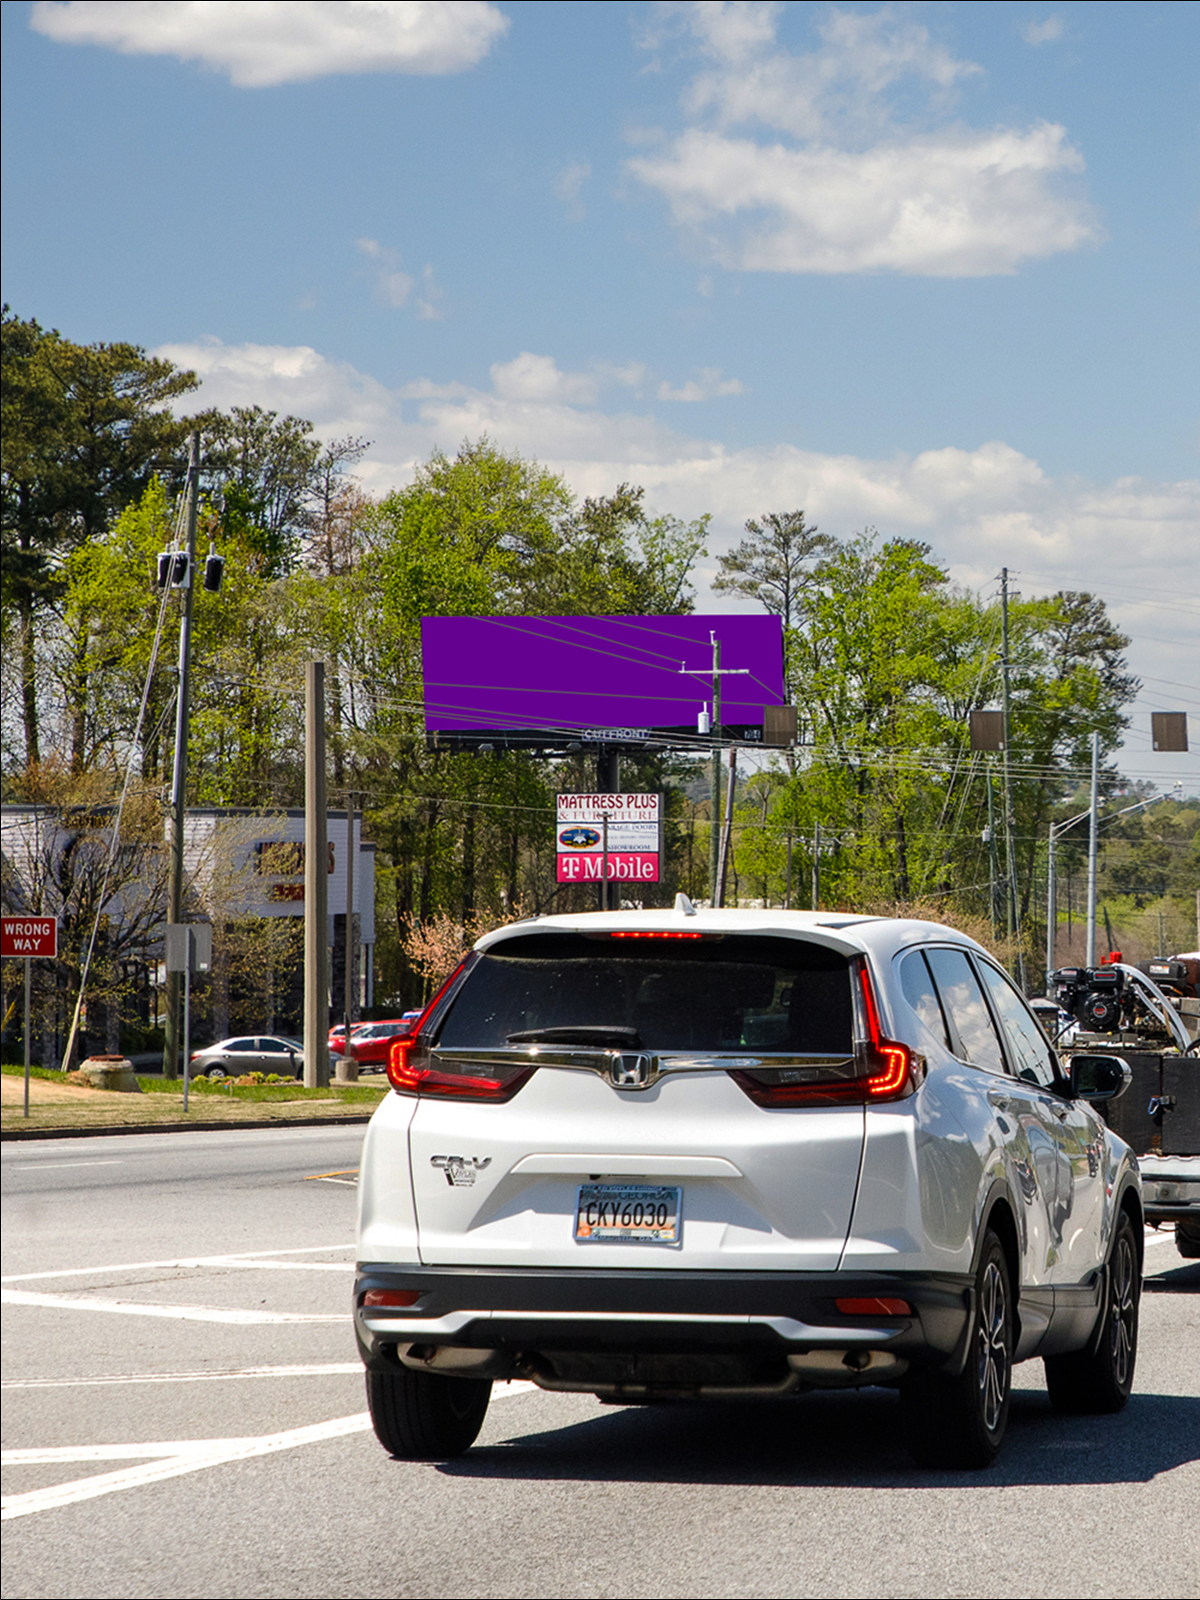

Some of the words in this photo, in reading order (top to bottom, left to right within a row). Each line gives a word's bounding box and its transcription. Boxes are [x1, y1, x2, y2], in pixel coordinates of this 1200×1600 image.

[558, 795, 624, 809] MATTRESS
[626, 795, 657, 809] PLUS
[558, 812, 569, 820] &
[4, 923, 51, 936] WRONG
[13, 939, 42, 951] WAY
[430, 1155, 492, 1170] CR-V
[586, 1202, 668, 1227] CKY6030
